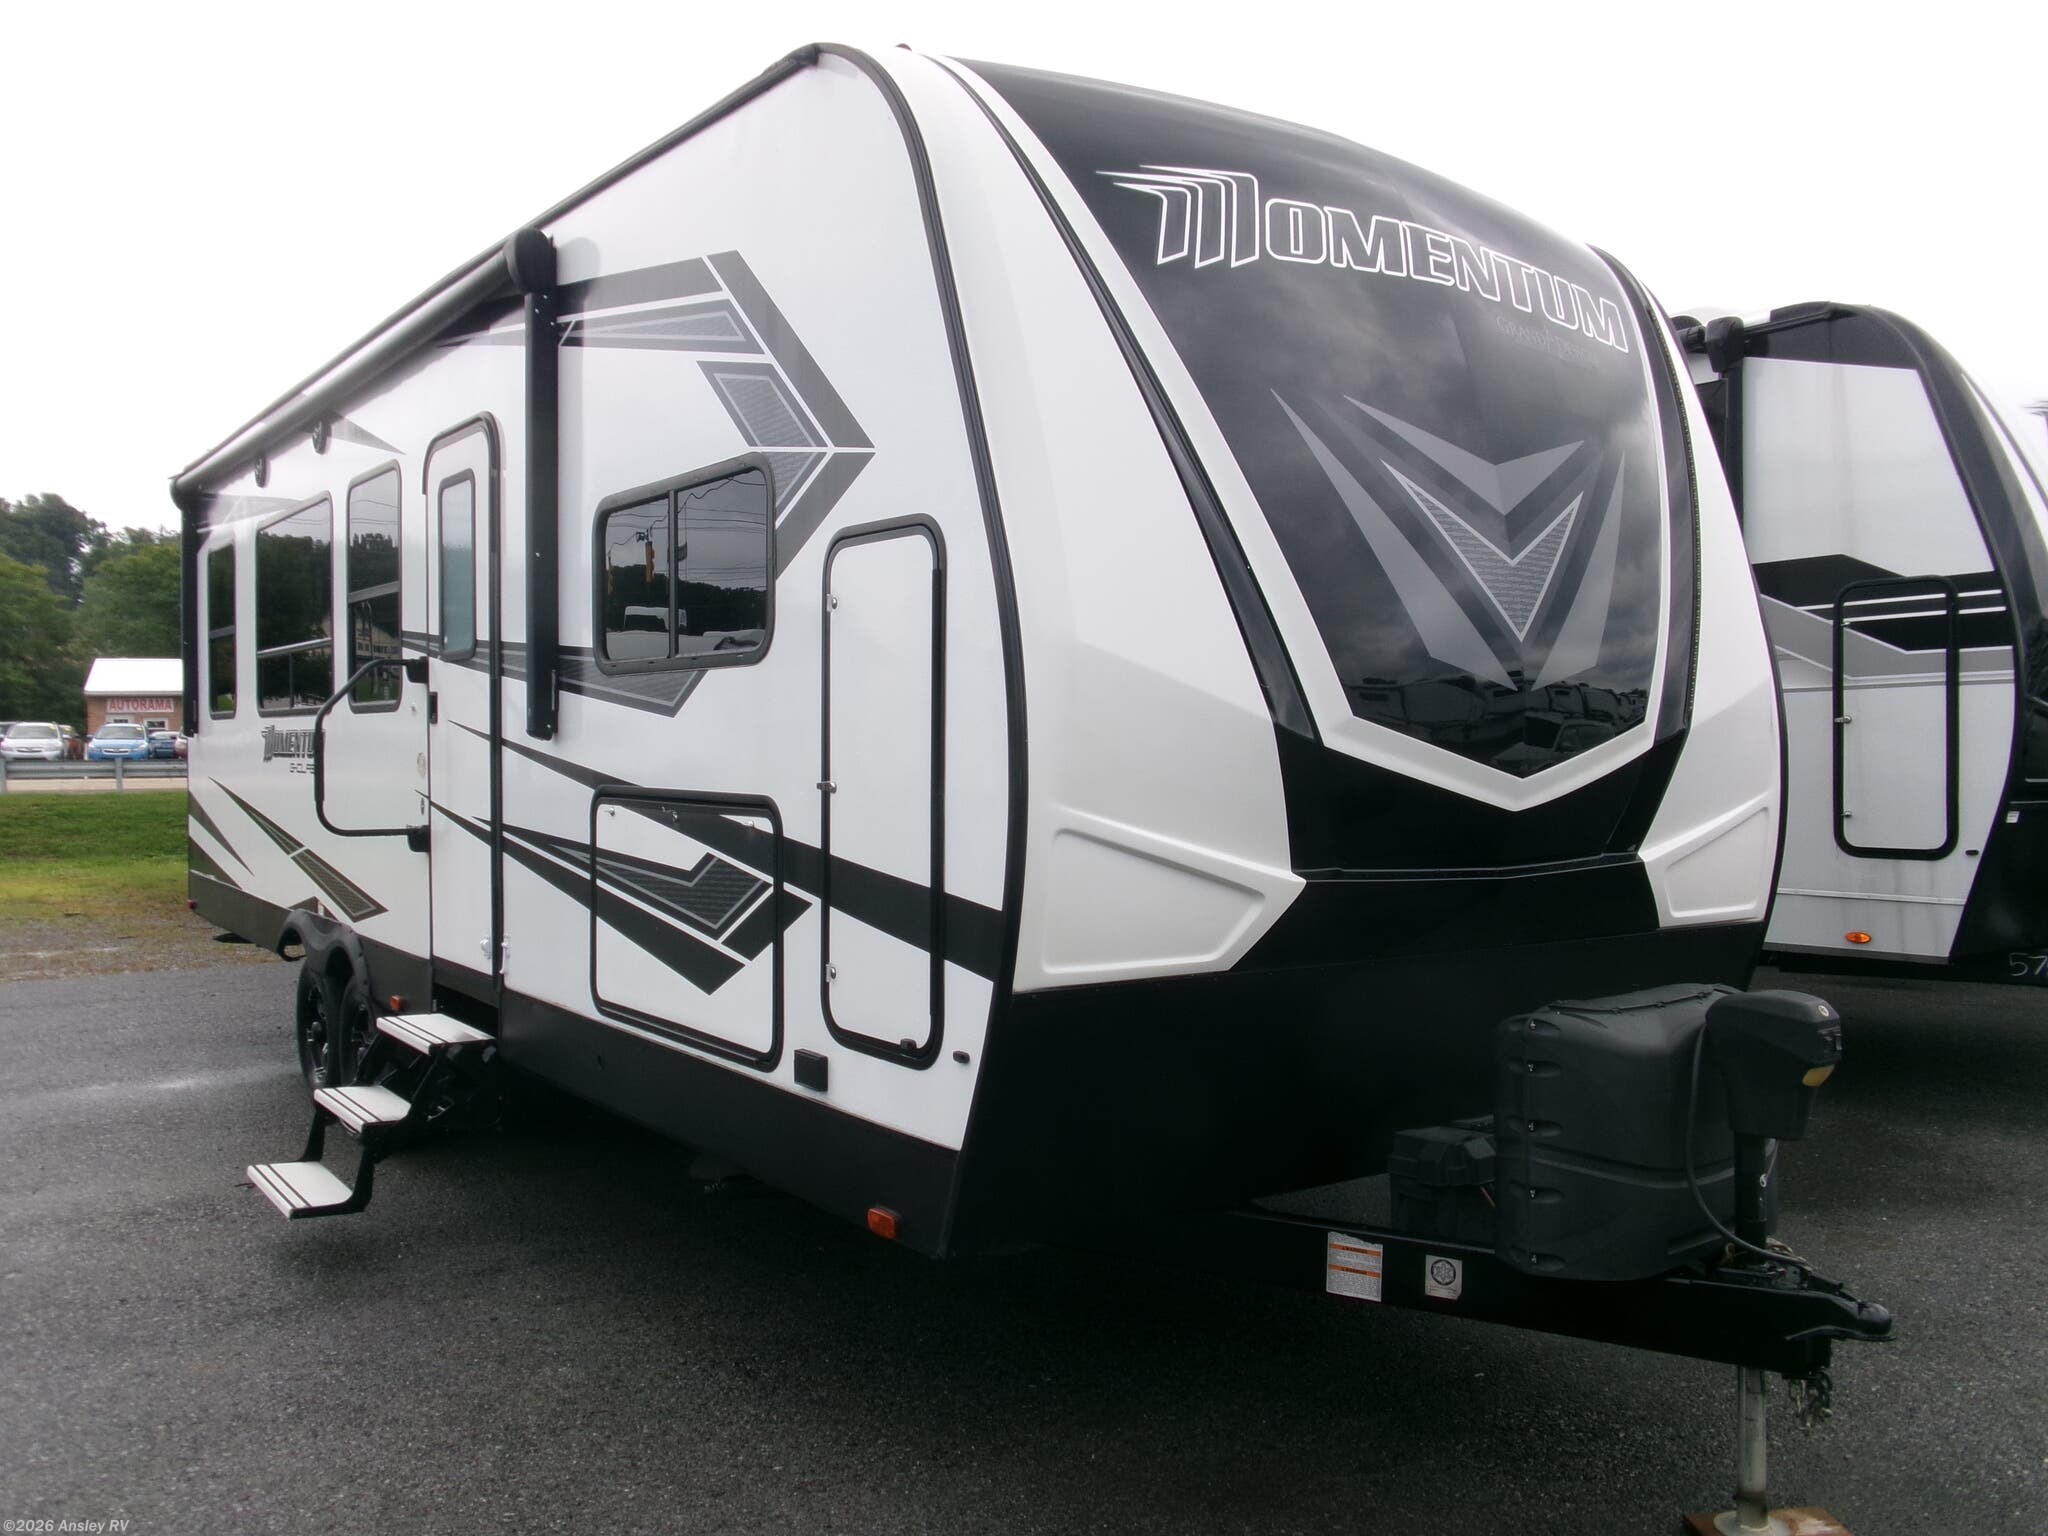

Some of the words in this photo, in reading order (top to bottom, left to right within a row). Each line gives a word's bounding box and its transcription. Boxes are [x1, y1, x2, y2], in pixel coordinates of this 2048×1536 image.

[1095, 163, 1629, 353] MOMENTUM
[109, 698, 173, 711] AUTORAMA
[261, 724, 326, 763] MOMENTU
